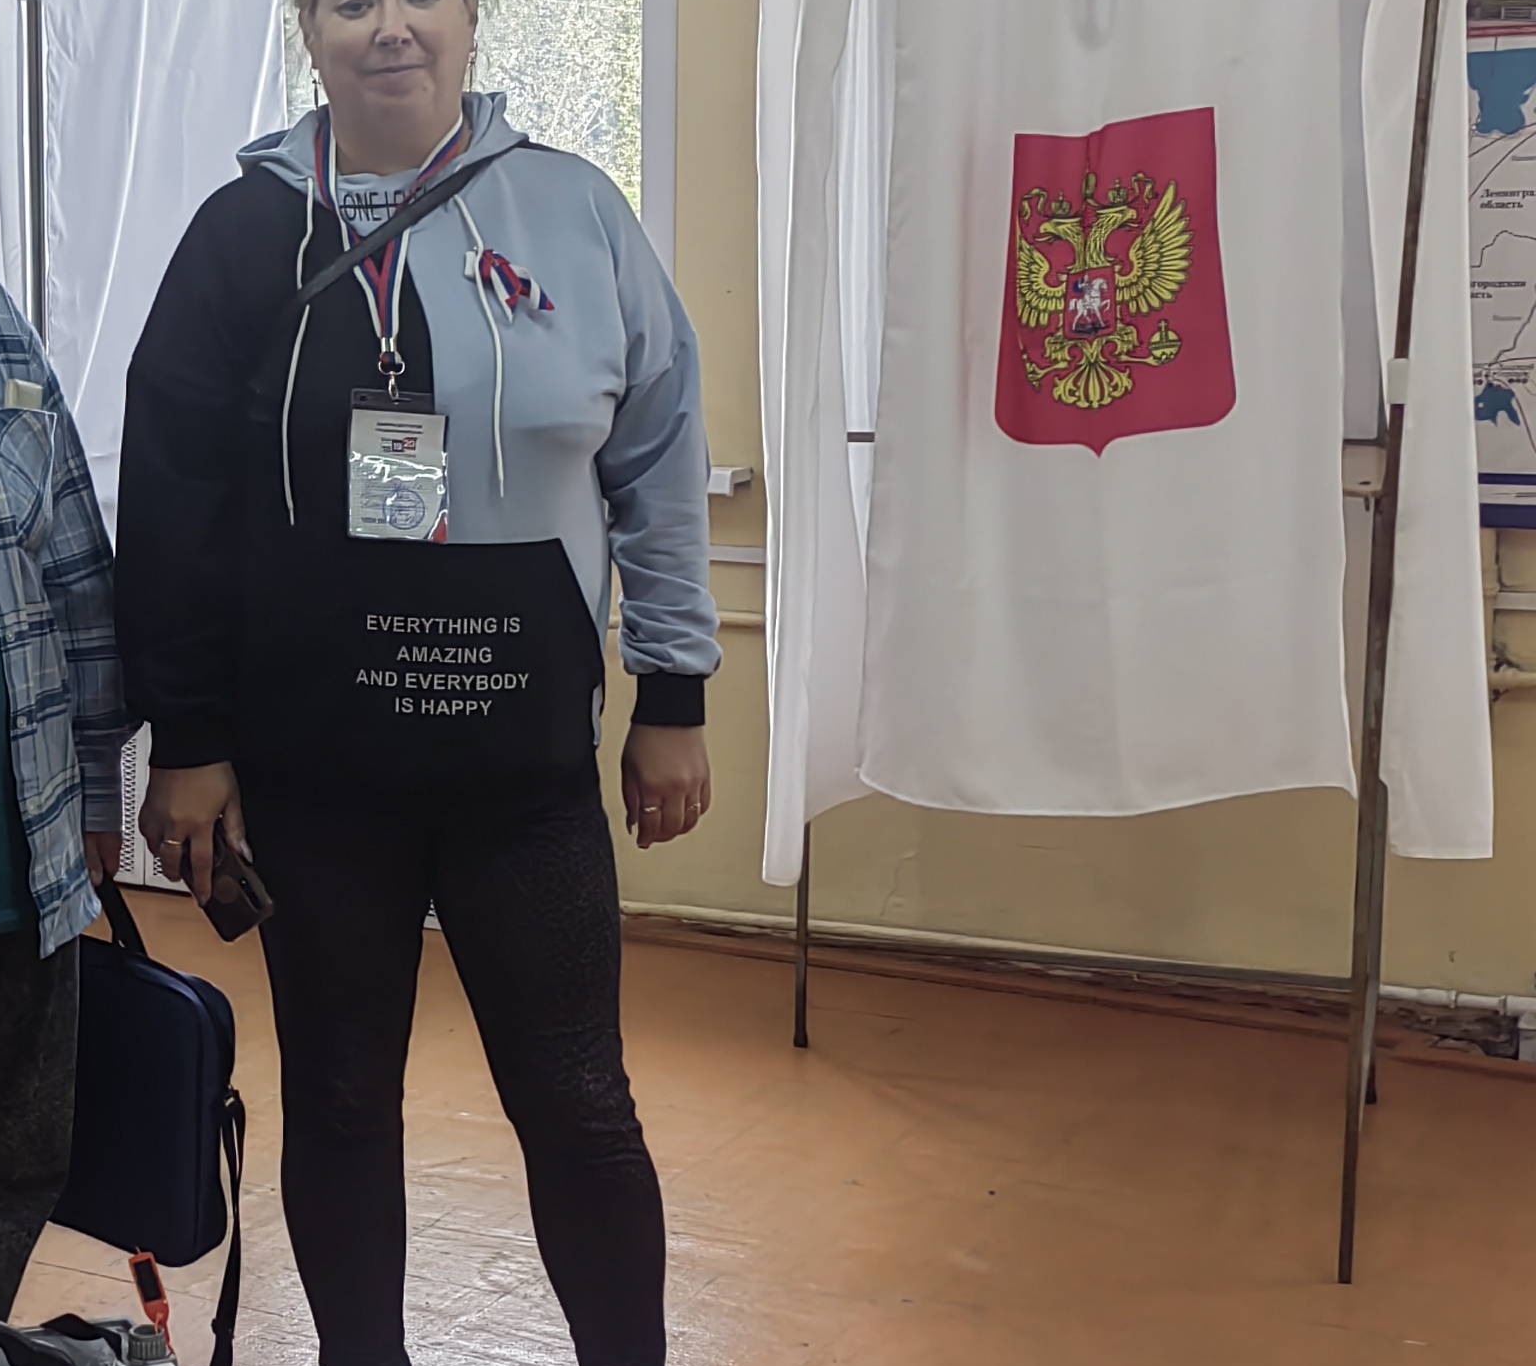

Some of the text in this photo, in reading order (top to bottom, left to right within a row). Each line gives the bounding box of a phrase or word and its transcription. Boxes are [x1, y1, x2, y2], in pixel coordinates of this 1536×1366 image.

[343, 191, 382, 222] ONE
[366, 614, 521, 634] EVERYTHING IS
[396, 646, 492, 664] AMAZING
[356, 669, 529, 691] AND EVERYBODY
[395, 697, 492, 716] IS HAPPY
